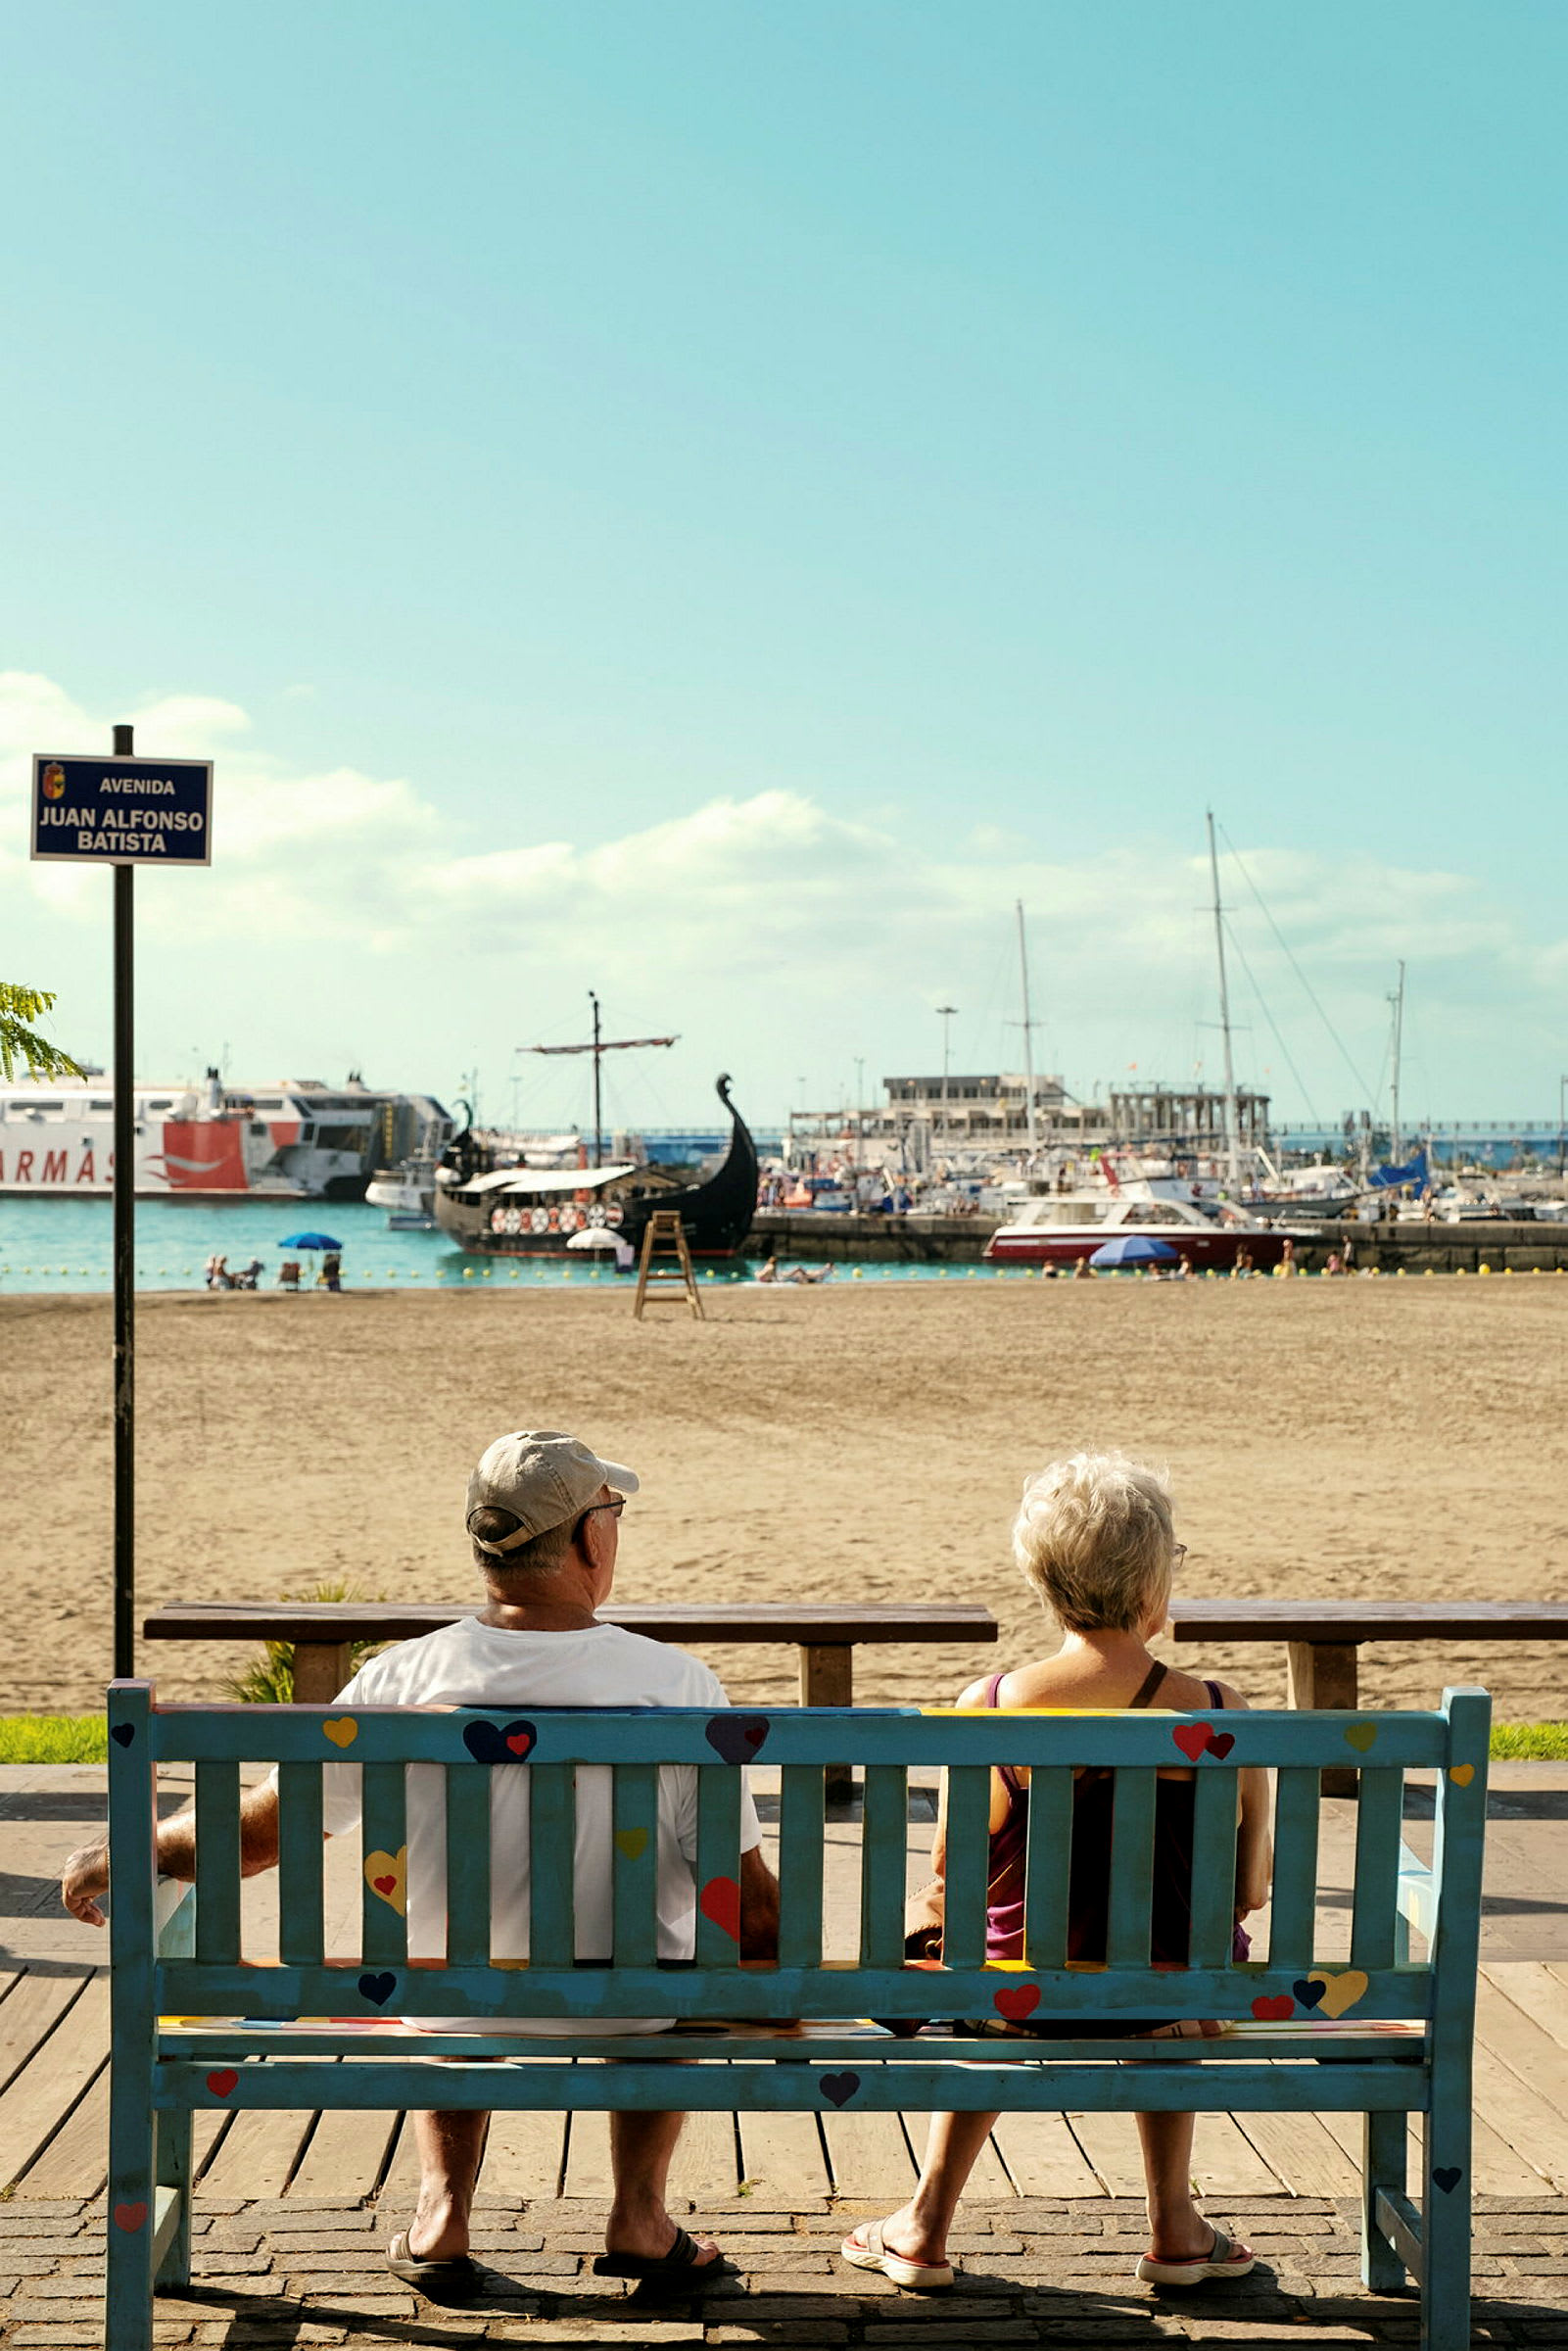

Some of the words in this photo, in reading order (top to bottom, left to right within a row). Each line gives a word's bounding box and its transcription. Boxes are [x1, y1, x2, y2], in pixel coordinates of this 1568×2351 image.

[99, 778, 175, 795] AVENIDA
[39, 807, 95, 827] JUAN
[102, 809, 204, 832] ALFONSO
[77, 832, 166, 852] BATISTA
[0, 1150, 115, 1183] RMA
